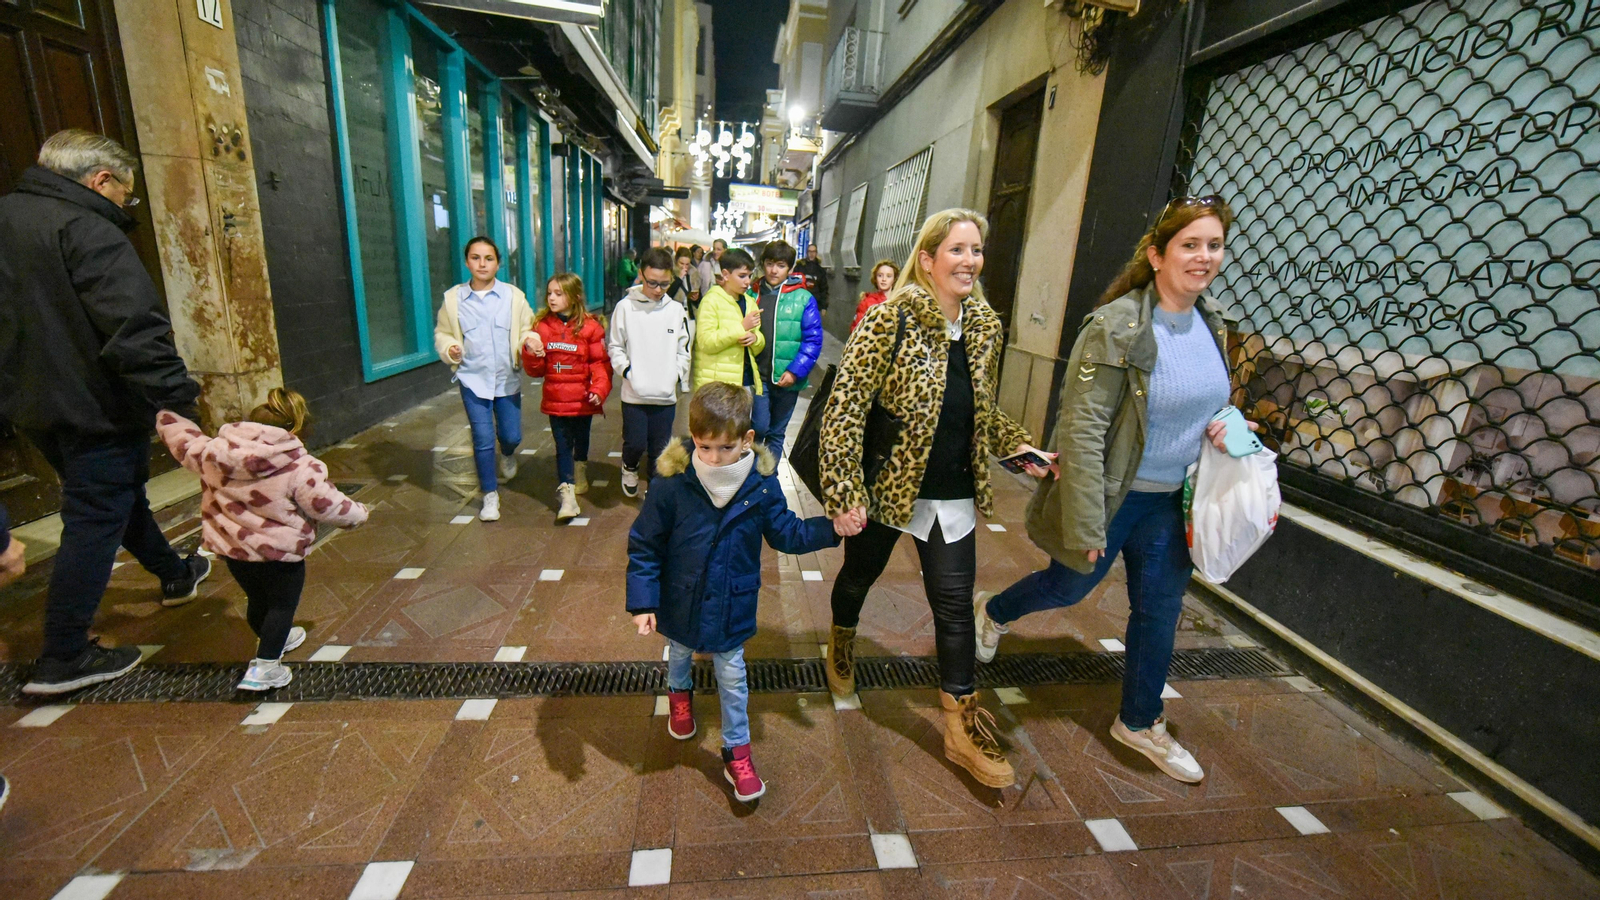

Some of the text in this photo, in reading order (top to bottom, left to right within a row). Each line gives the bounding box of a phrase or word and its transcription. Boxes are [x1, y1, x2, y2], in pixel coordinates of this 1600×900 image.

[1316, 19, 1512, 103] EDIFICIO
[1437, 100, 1600, 157] REFOR
[1346, 165, 1531, 208] INTEGRAL
[1249, 261, 1262, 280] 4
[1289, 295, 1531, 336] 2 COMERCIOS
